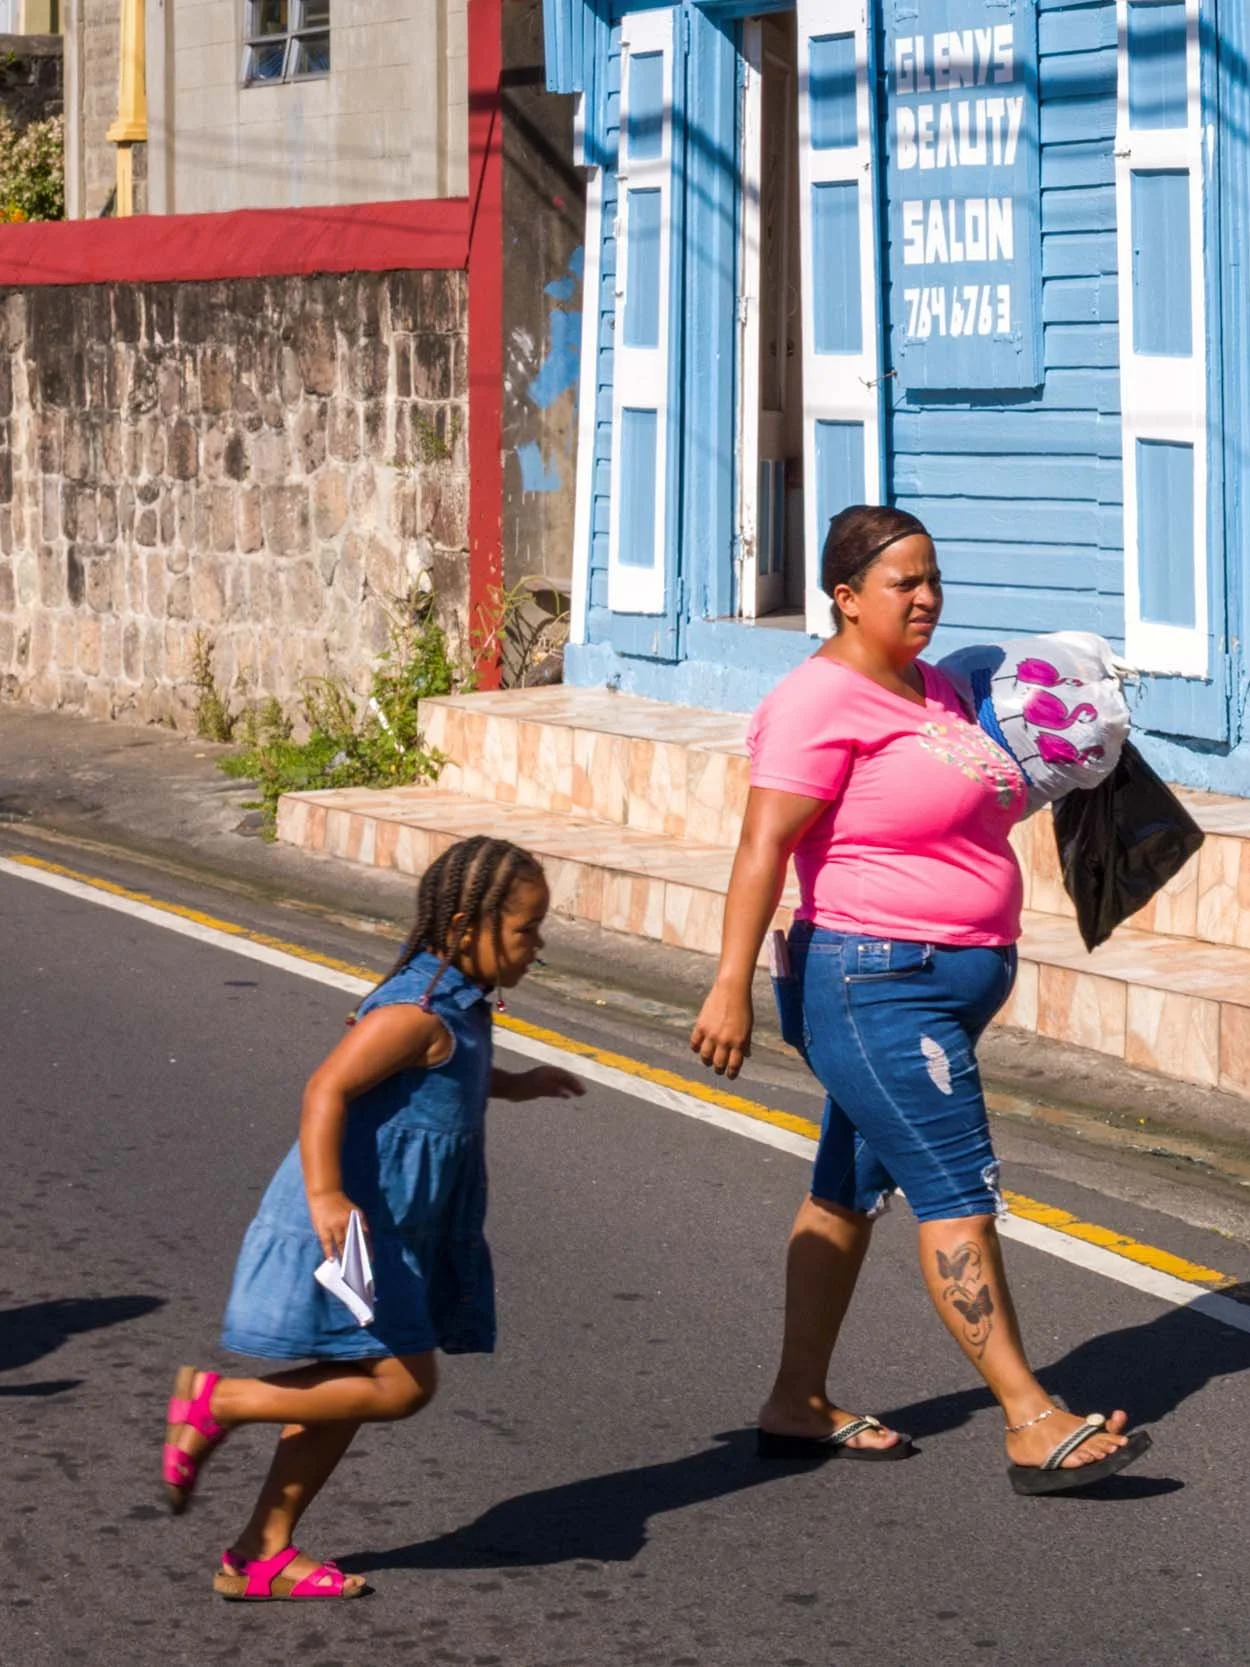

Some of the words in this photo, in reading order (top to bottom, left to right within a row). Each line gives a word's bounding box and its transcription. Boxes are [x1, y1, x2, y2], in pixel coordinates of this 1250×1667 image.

[895, 23, 1013, 95] GLENYS
[896, 97, 1023, 170] BEAUTY
[903, 198, 1013, 265] SALON
